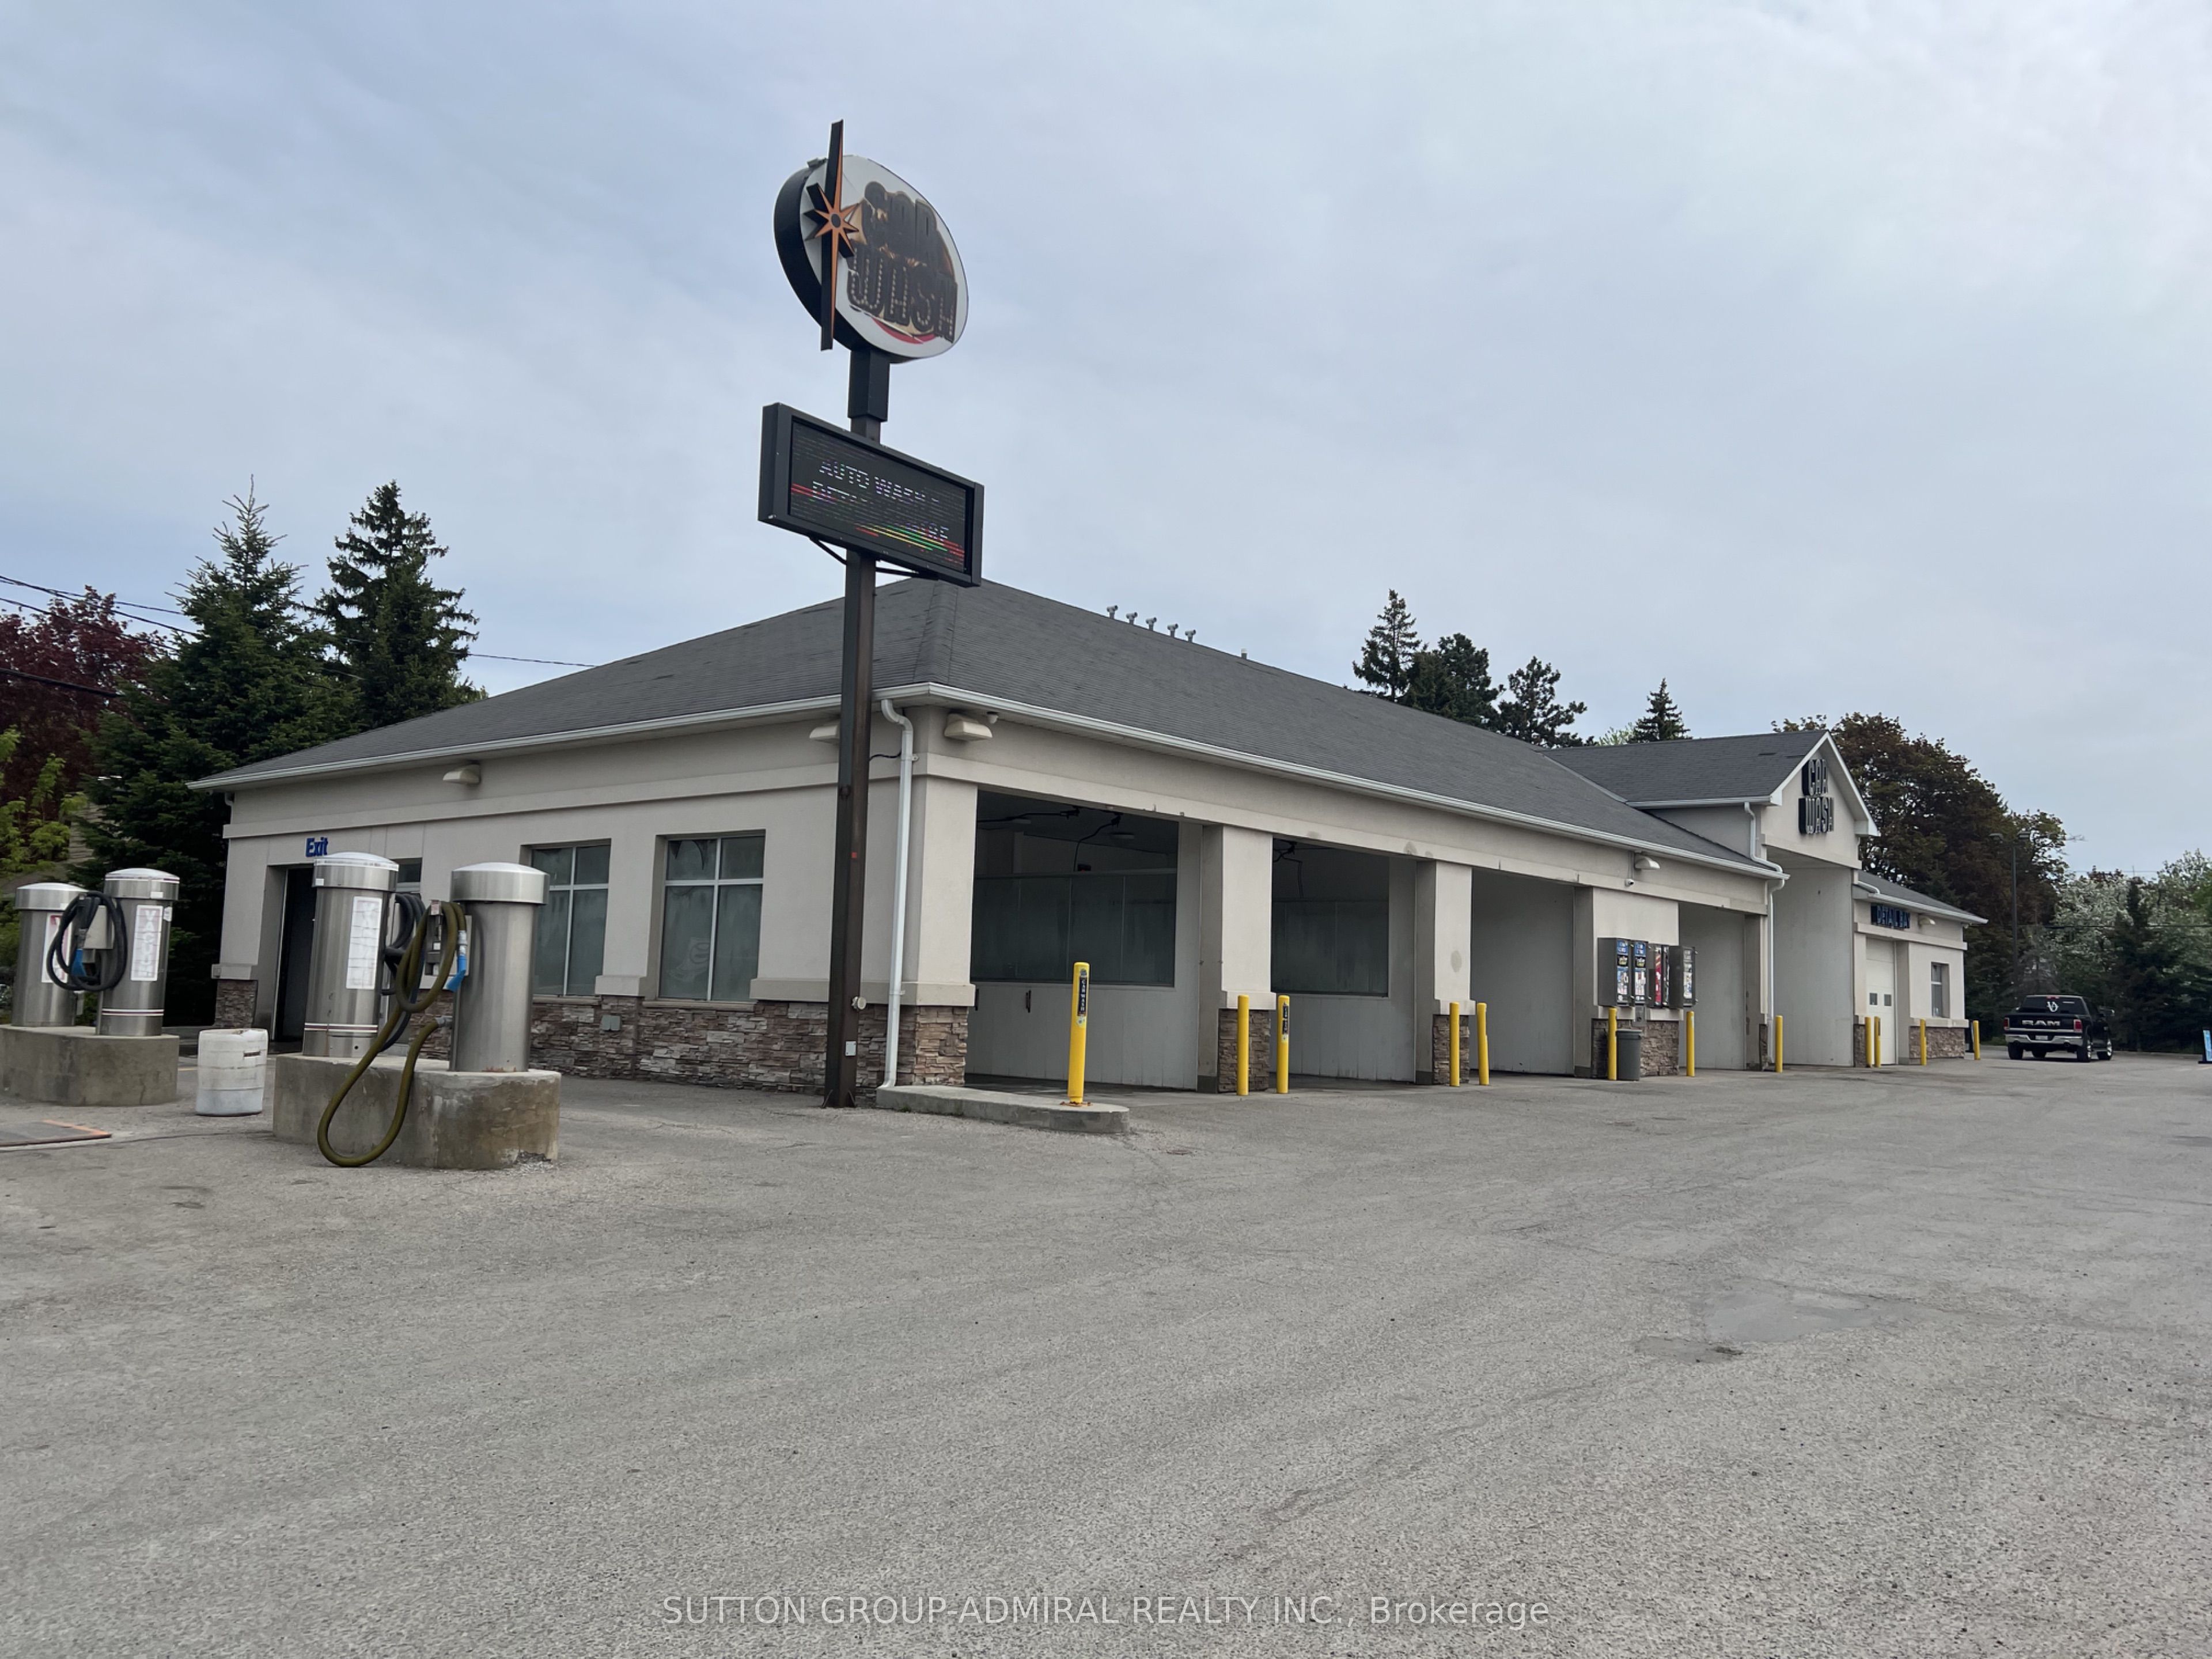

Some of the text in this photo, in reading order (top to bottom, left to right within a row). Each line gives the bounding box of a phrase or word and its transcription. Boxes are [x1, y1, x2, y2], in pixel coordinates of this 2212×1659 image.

[819, 461, 870, 489] AUTO
[1806, 759, 1828, 796] CAR
[1804, 797, 1834, 835] WASH
[305, 837, 328, 857] Exit
